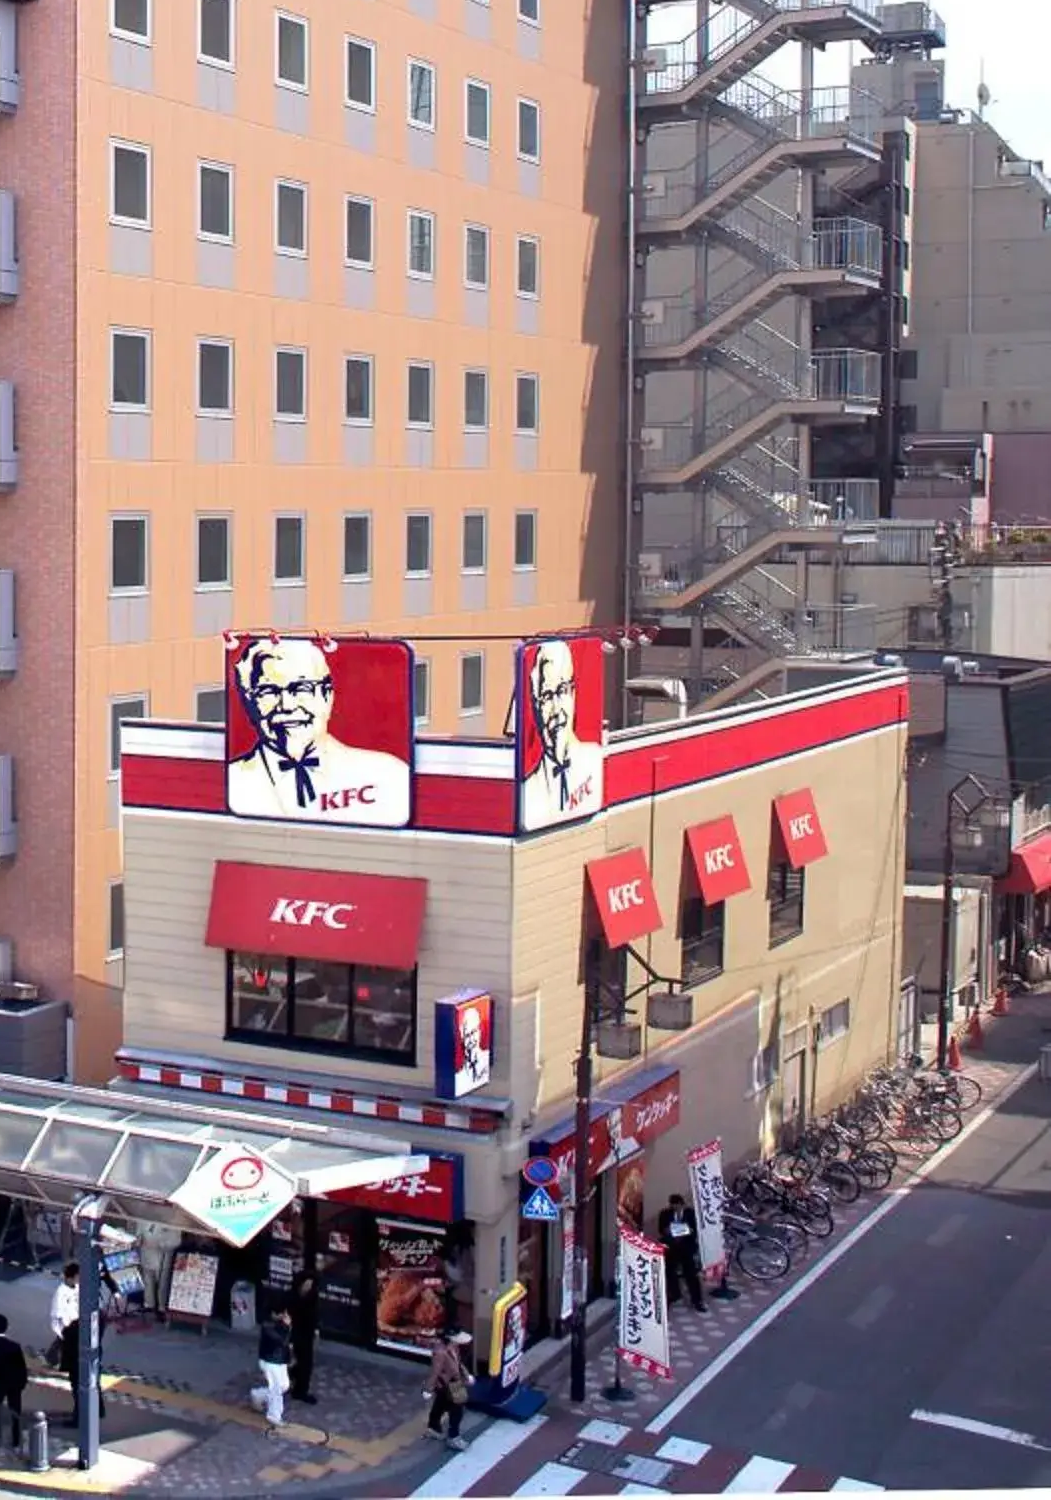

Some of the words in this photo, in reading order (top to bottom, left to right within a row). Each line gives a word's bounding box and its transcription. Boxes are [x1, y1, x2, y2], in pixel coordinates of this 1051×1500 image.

[320, 785, 376, 812] KFC
[568, 774, 593, 811] KFC
[789, 813, 814, 840] KFC
[704, 843, 735, 875] KFC
[607, 879, 645, 913] KFC
[269, 898, 355, 929] KFC
